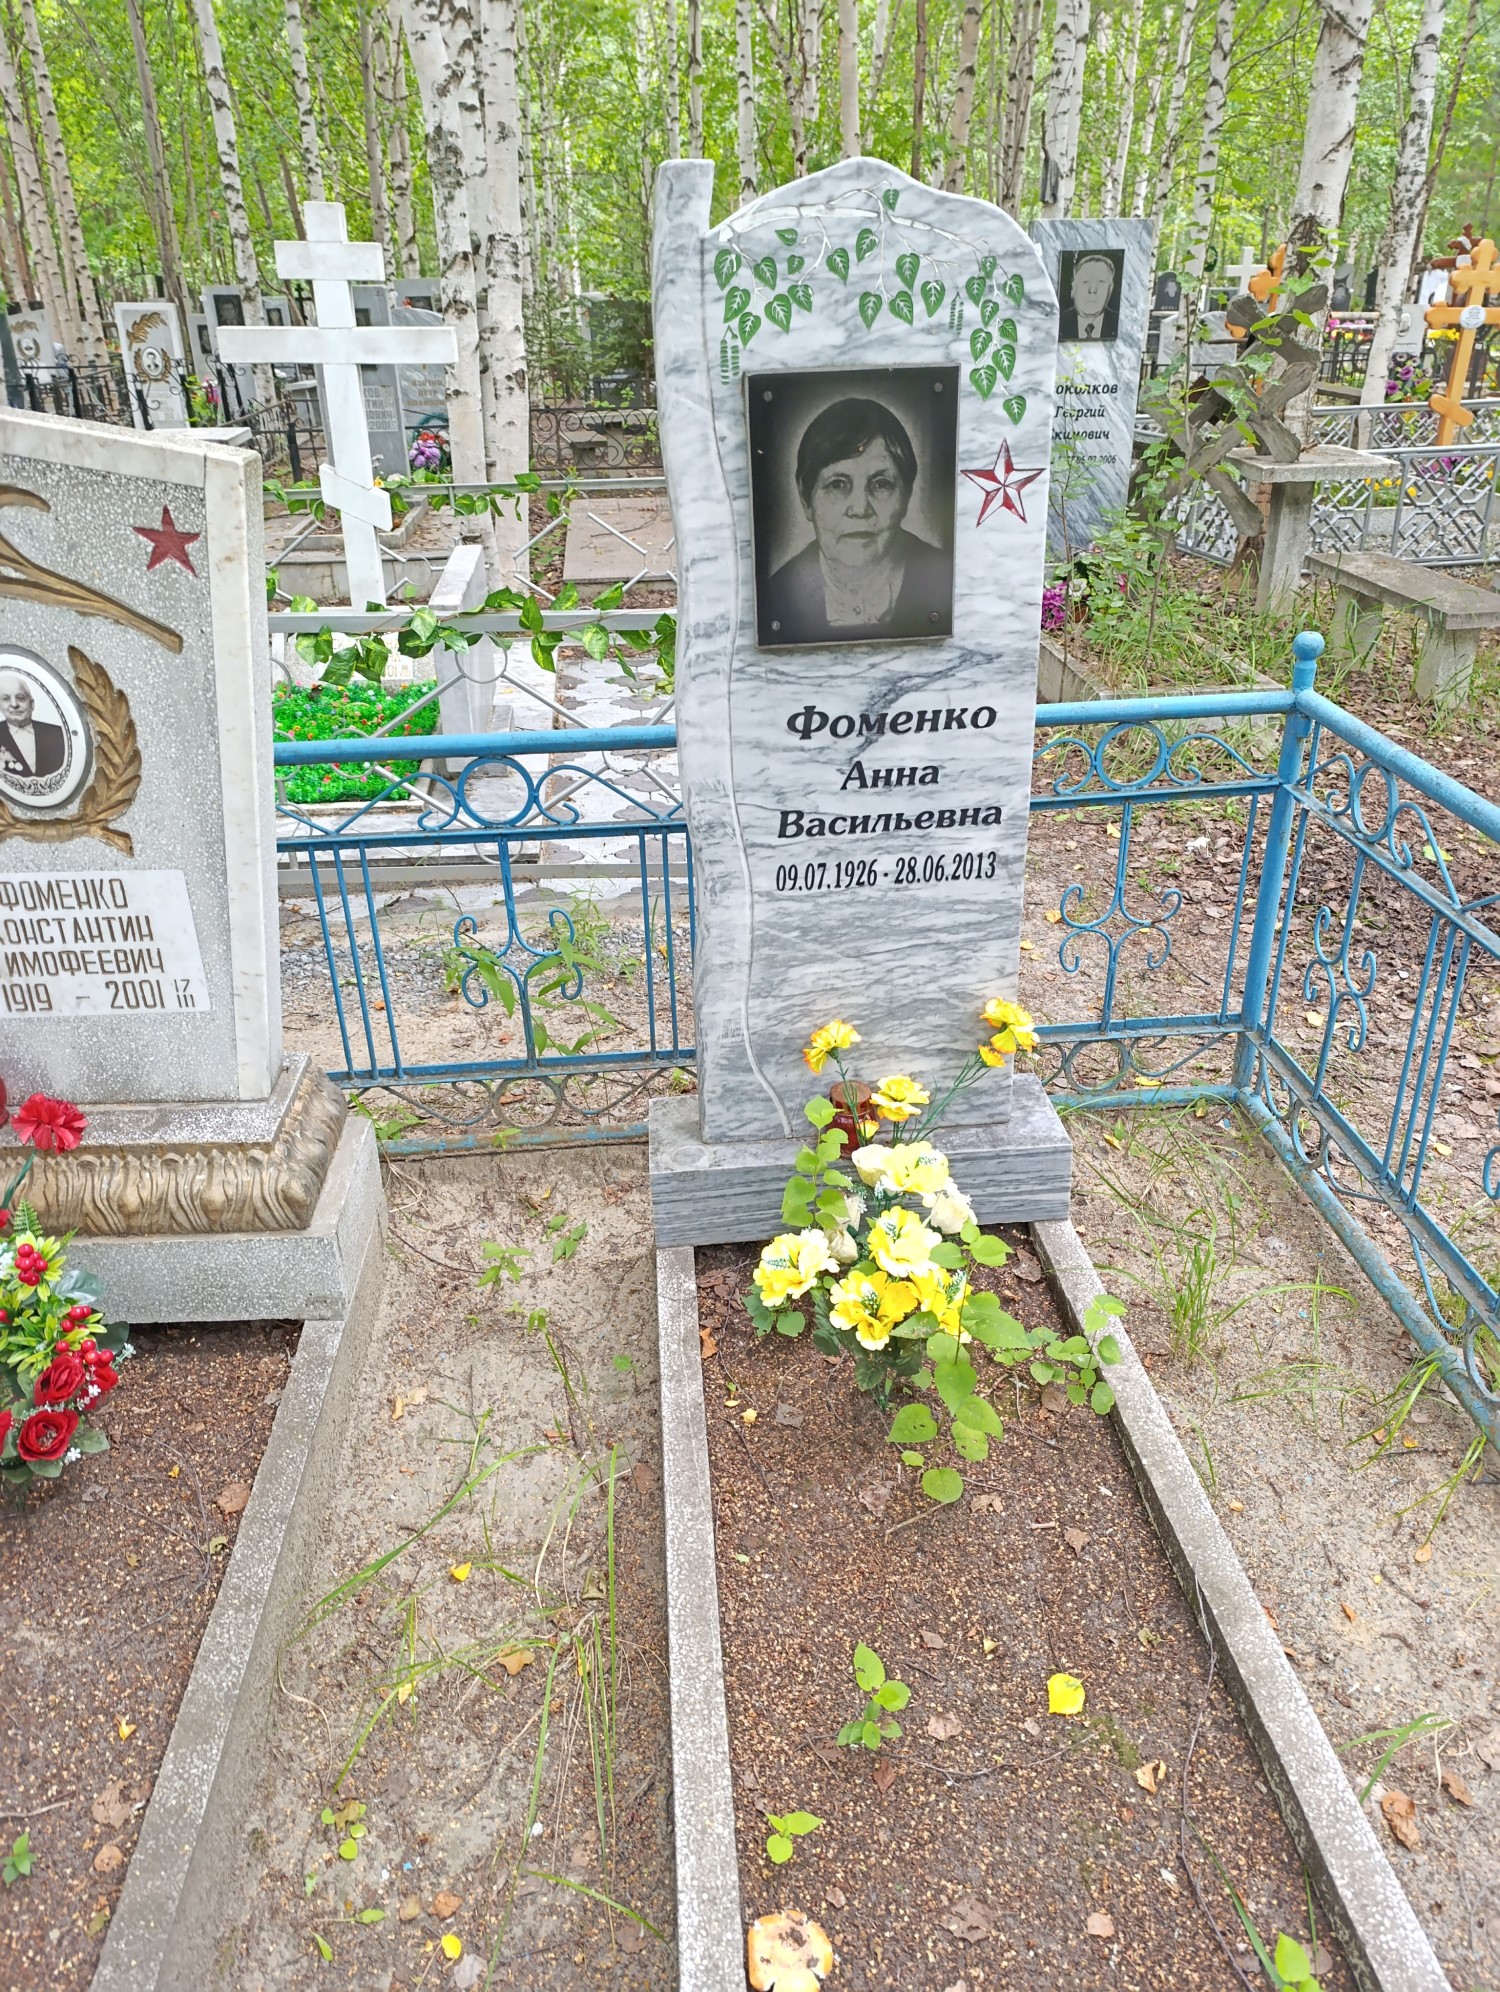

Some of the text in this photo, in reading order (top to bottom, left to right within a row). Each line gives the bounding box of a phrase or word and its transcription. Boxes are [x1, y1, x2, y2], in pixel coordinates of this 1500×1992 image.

[1056, 384, 1118, 394] околков
[1052, 428, 1110, 441] кимович
[786, 705, 998, 740] Фоменко
[840, 760, 940, 790] Анна
[777, 805, 1003, 839] Васильевна
[776, 858, 878, 892] 09.07.1926
[894, 851, 997, 884] 28.06.2013
[0, 879, 129, 911] ФОМЕНКО
[4, 947, 165, 977] ИМОФЕЕВИЧ
[2, 983, 53, 1012] 1919
[105, 980, 165, 1009] 2001
